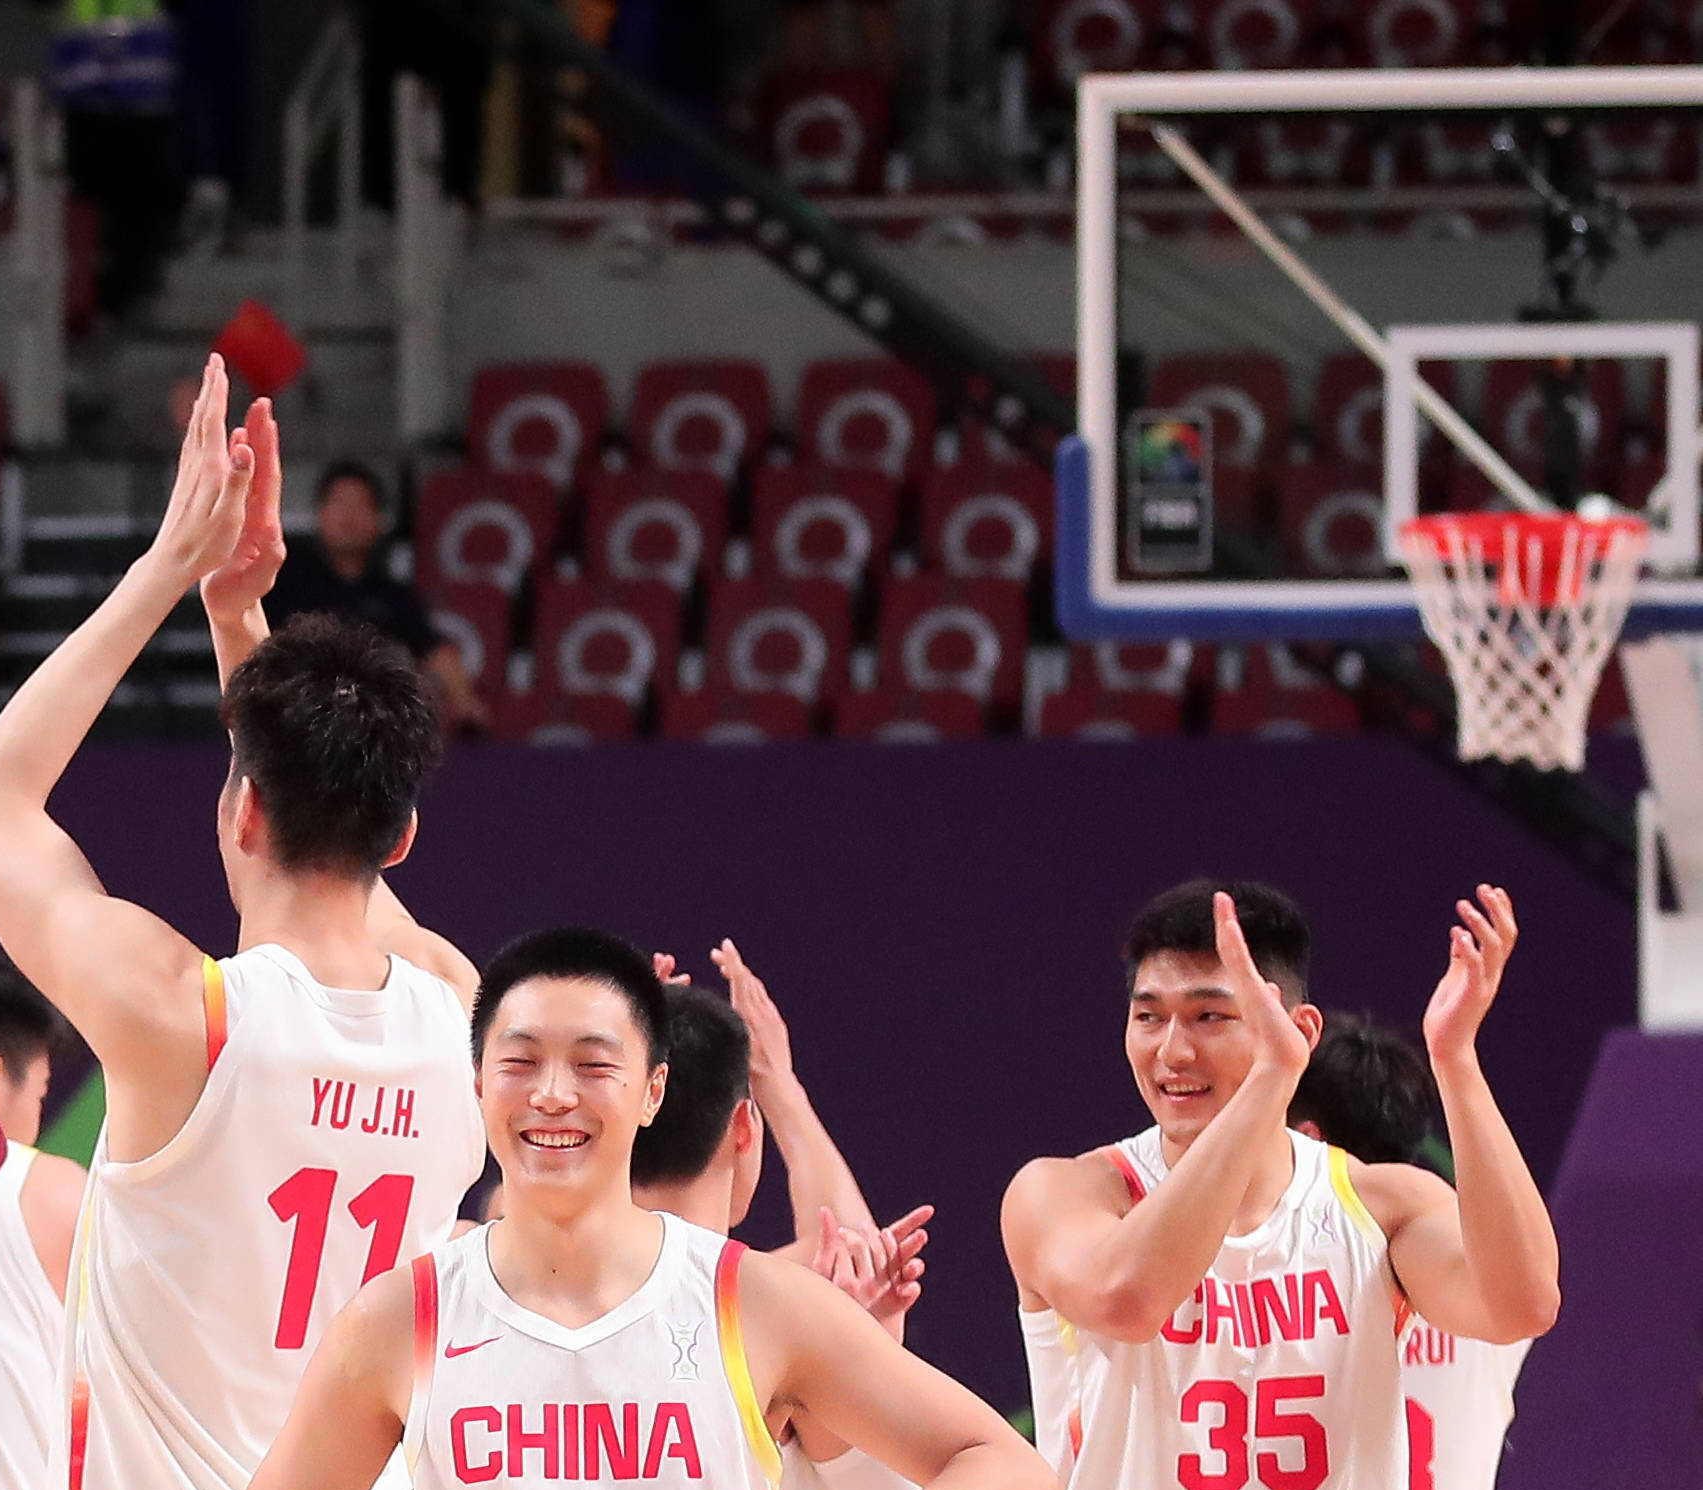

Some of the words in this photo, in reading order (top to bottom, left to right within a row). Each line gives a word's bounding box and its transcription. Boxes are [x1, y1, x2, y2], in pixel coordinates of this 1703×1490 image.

[311, 1077, 356, 1129] YU
[361, 1086, 419, 1138] J.H.
[268, 1166, 414, 1350] 11
[1160, 1269, 1350, 1348] CHINA
[450, 1402, 702, 1485] CHINA
